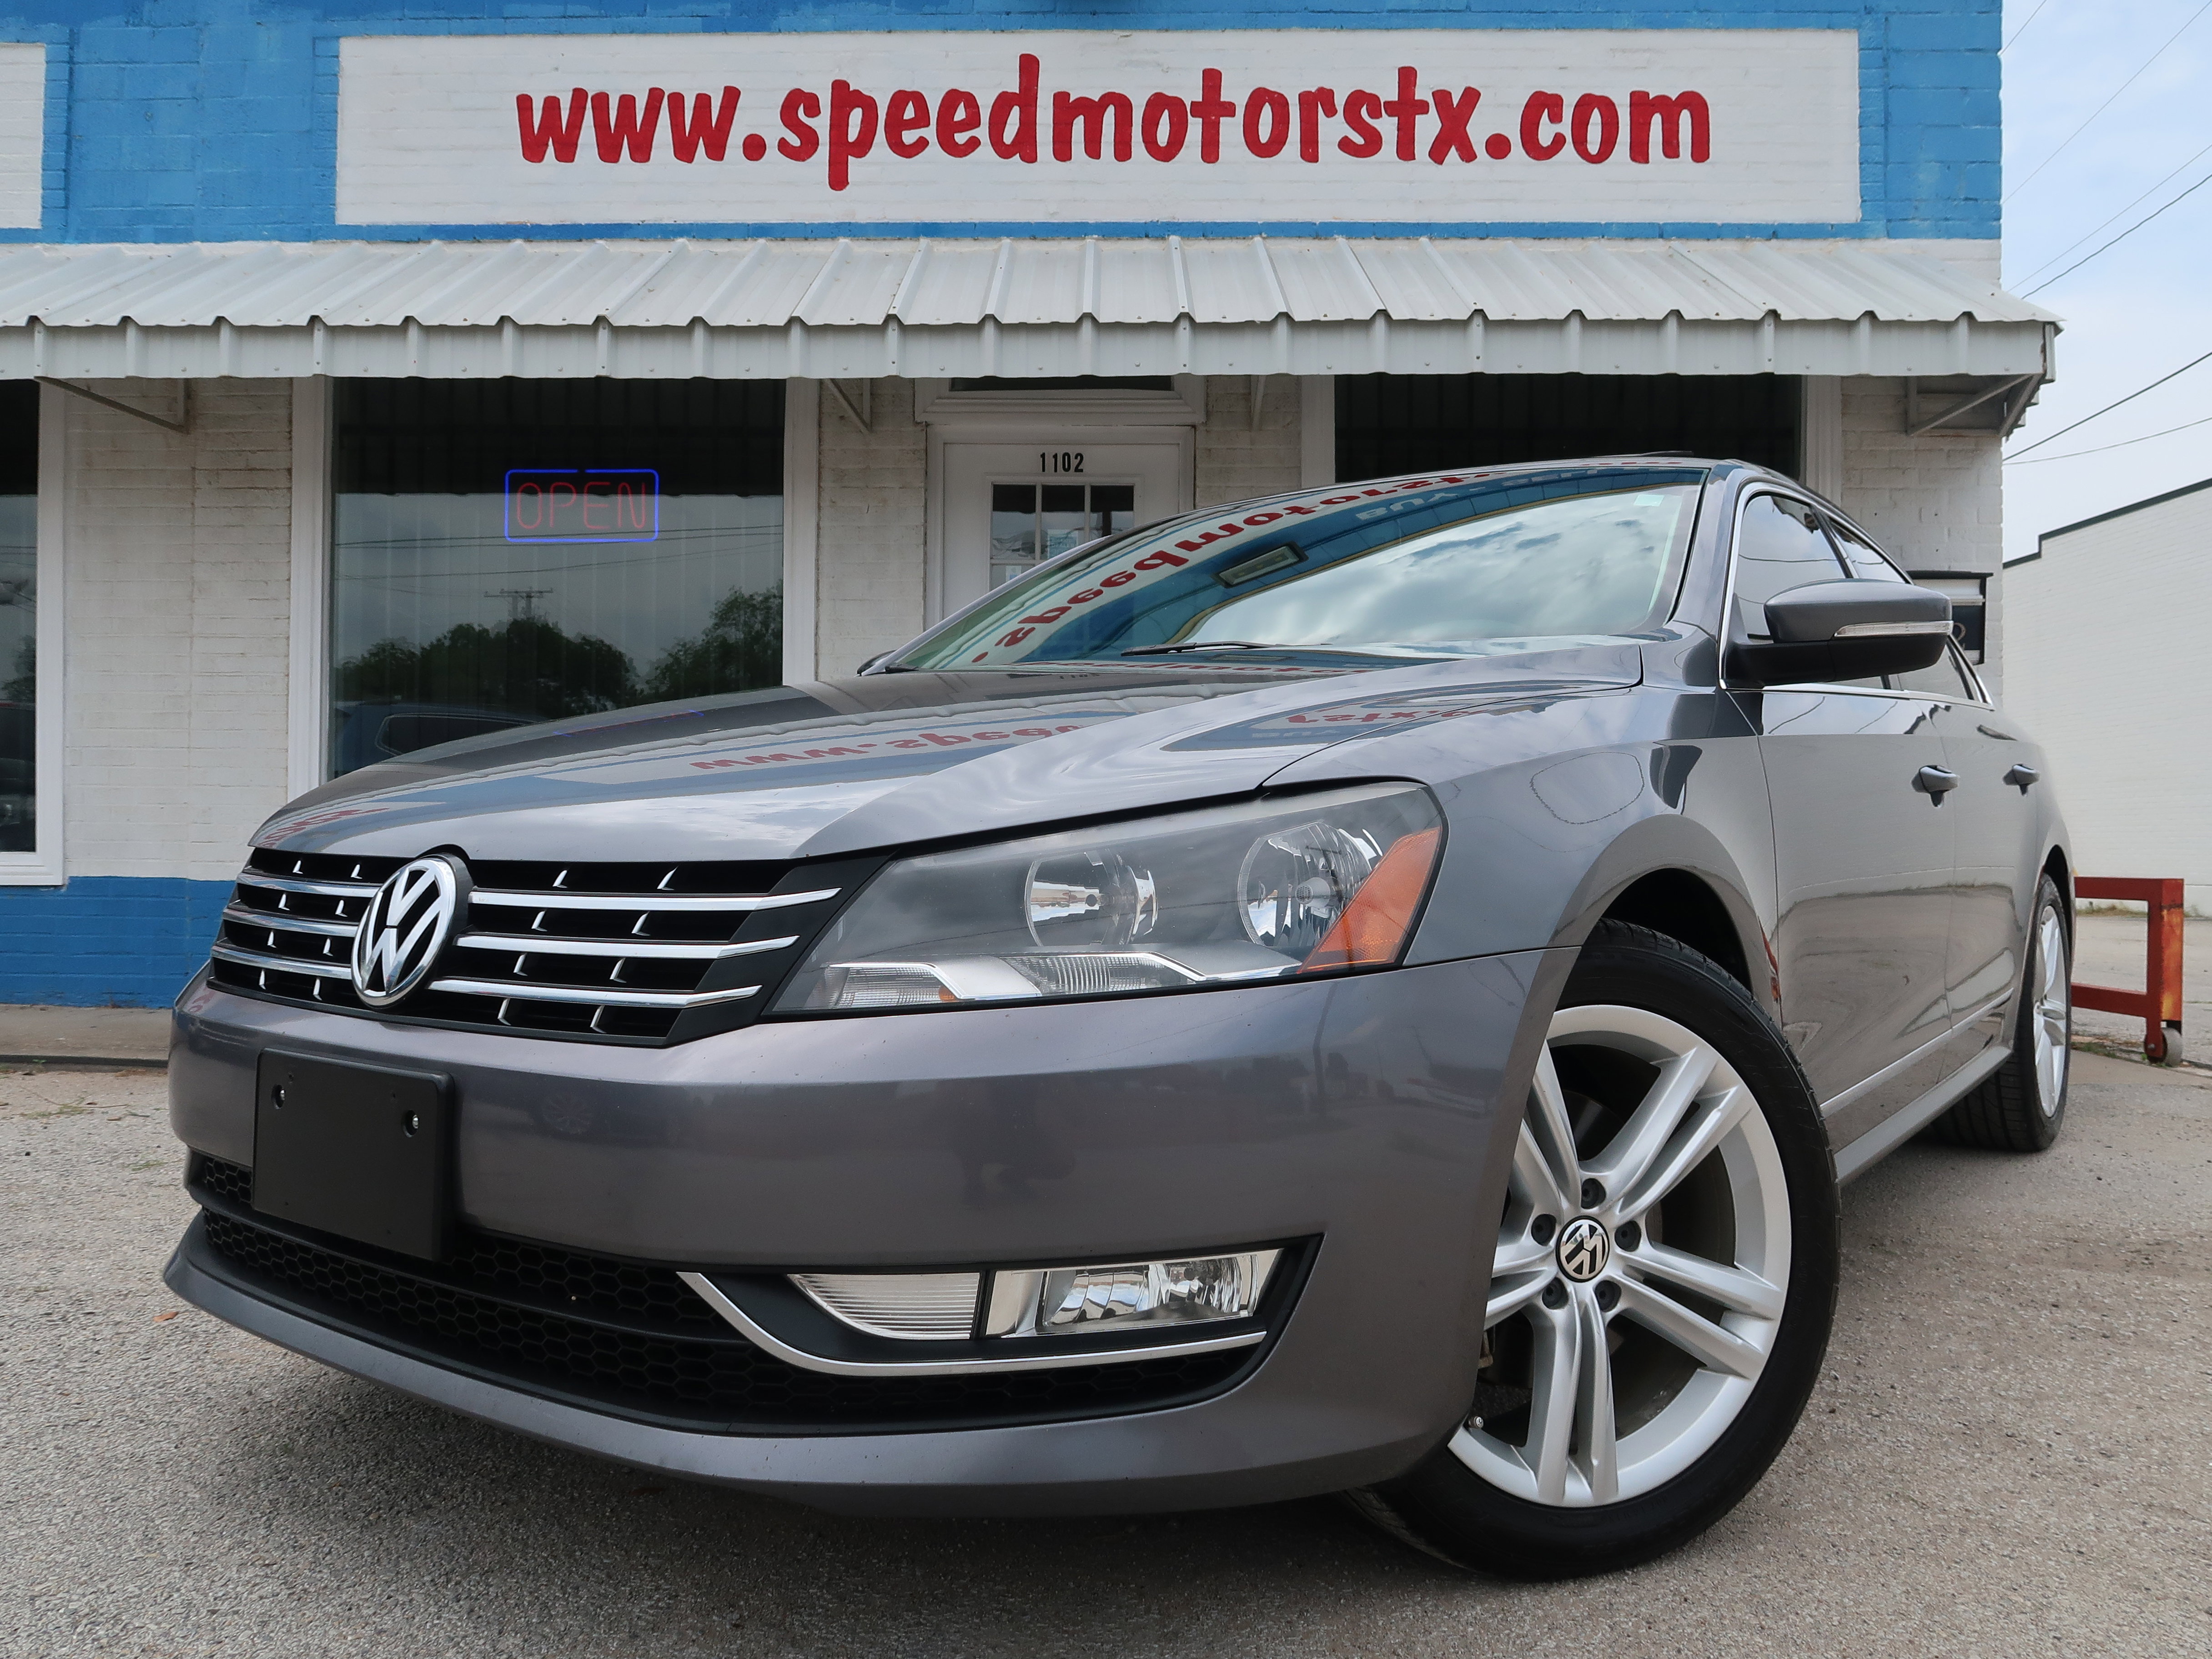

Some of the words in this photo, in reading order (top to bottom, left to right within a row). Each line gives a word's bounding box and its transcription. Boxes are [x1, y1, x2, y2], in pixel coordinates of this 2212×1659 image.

[517, 53, 1710, 191] www.speedmotorstx.com
[517, 481, 646, 529] OPEN
[1040, 452, 1084, 473] 1102
[355, 860, 452, 1003] VW
